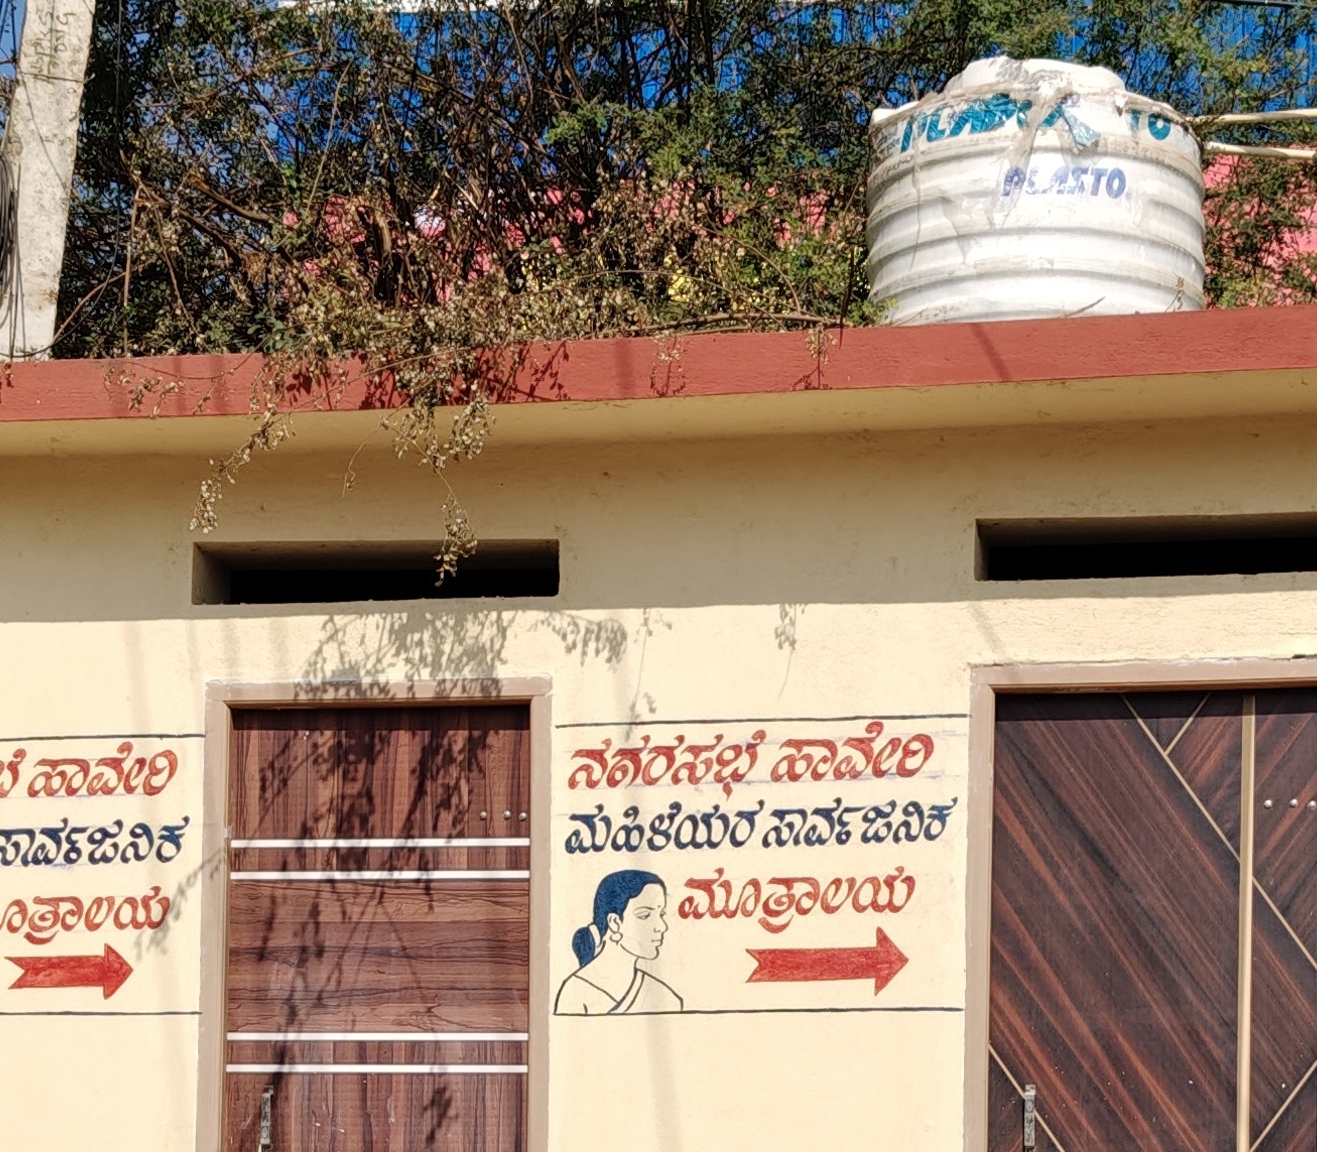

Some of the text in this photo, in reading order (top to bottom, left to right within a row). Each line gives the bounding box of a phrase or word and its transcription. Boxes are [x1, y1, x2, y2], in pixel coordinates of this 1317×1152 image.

[27, 741, 179, 799] ಹಾವೇರಿ
[567, 721, 935, 801] ನಗರಸಭೆ ಹಾವೇರಿ
[564, 797, 765, 855] ಮಹಿಳೆಯರ
[677, 866, 916, 934] ಮೂತ್ರಾಲಯ
